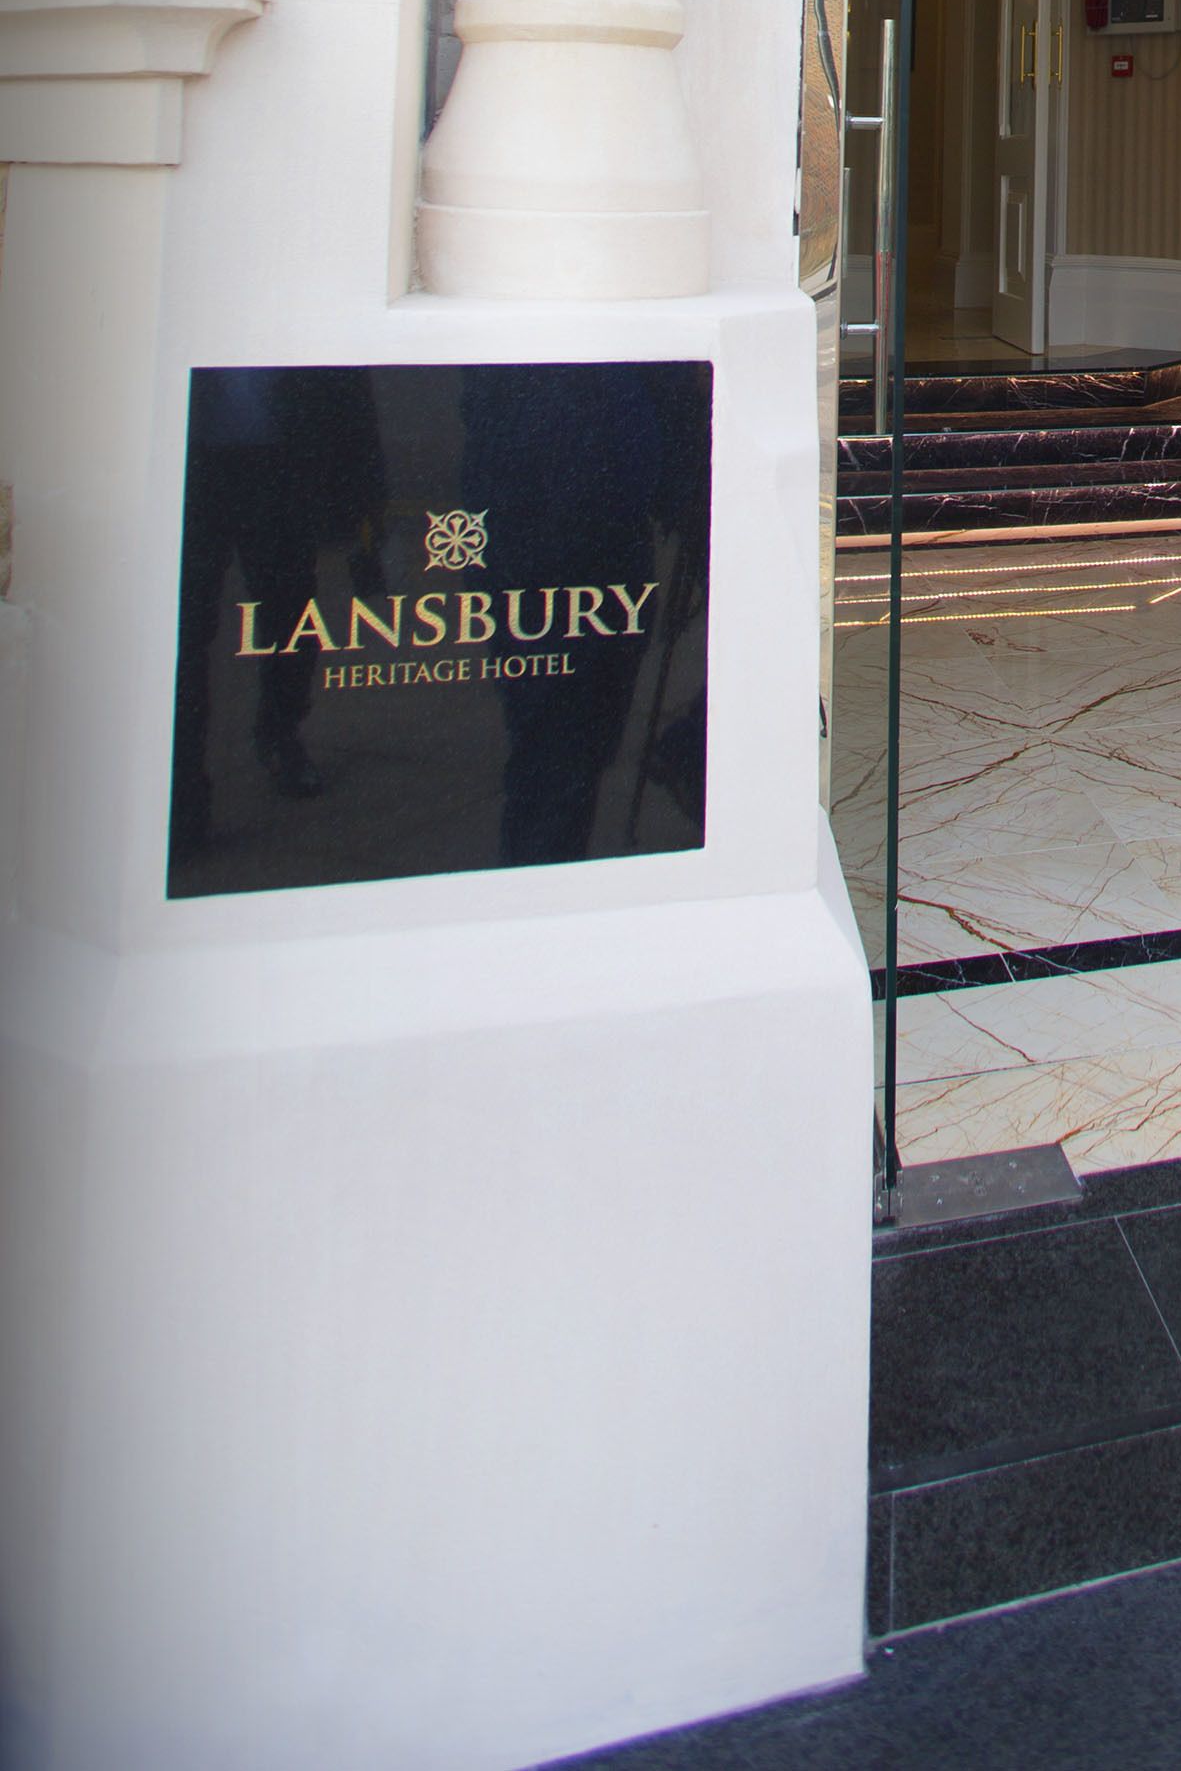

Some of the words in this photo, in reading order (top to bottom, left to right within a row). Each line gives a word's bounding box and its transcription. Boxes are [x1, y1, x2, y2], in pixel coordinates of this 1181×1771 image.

[235, 582, 659, 656] LANSBURY
[323, 658, 471, 689] HERITAGE
[480, 653, 576, 679] HOTEL
